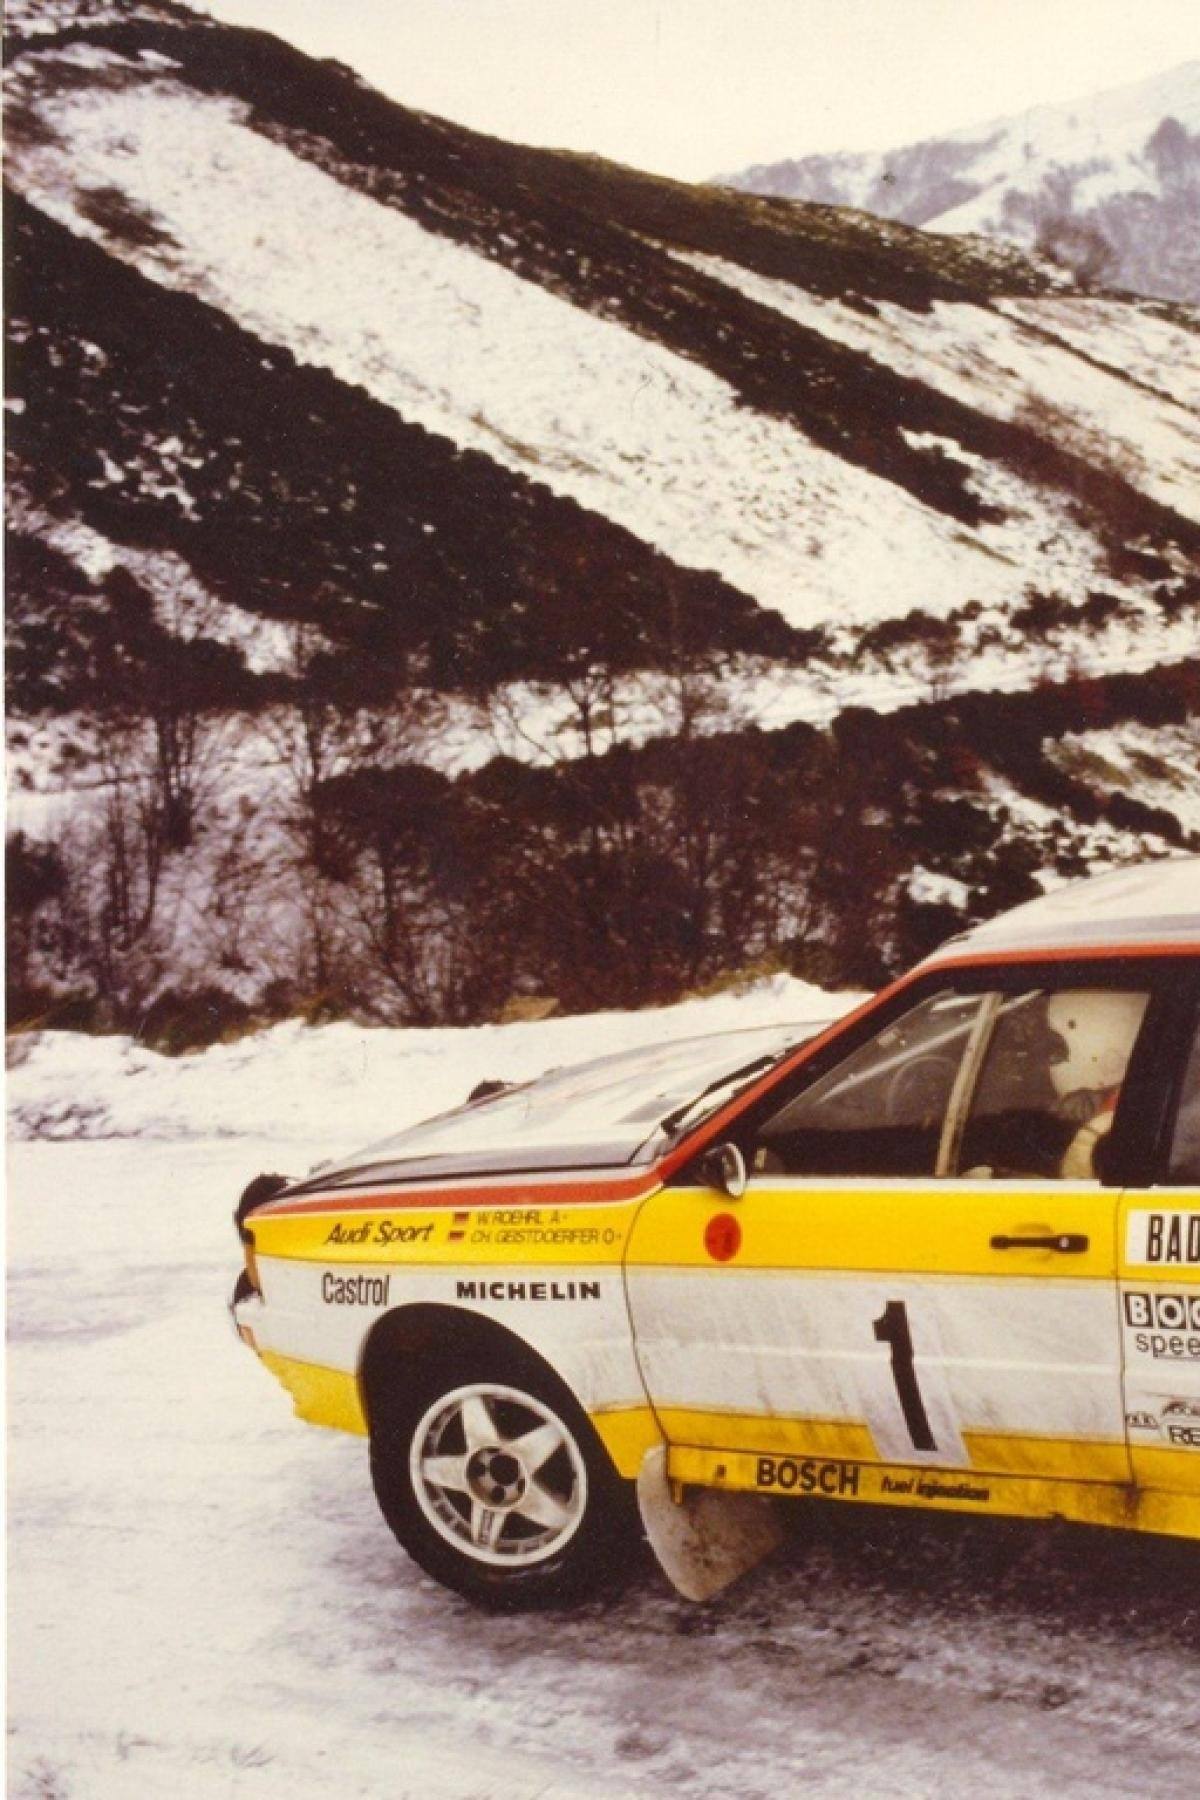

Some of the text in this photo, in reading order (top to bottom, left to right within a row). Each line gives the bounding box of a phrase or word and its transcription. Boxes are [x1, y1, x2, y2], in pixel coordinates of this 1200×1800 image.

[323, 1220, 435, 1247] Audi Sport
[322, 1272, 390, 1306] Castrol
[456, 1281, 600, 1300] MICHELIN
[873, 1300, 937, 1450] 1
[756, 1457, 859, 1496] BOSCH
